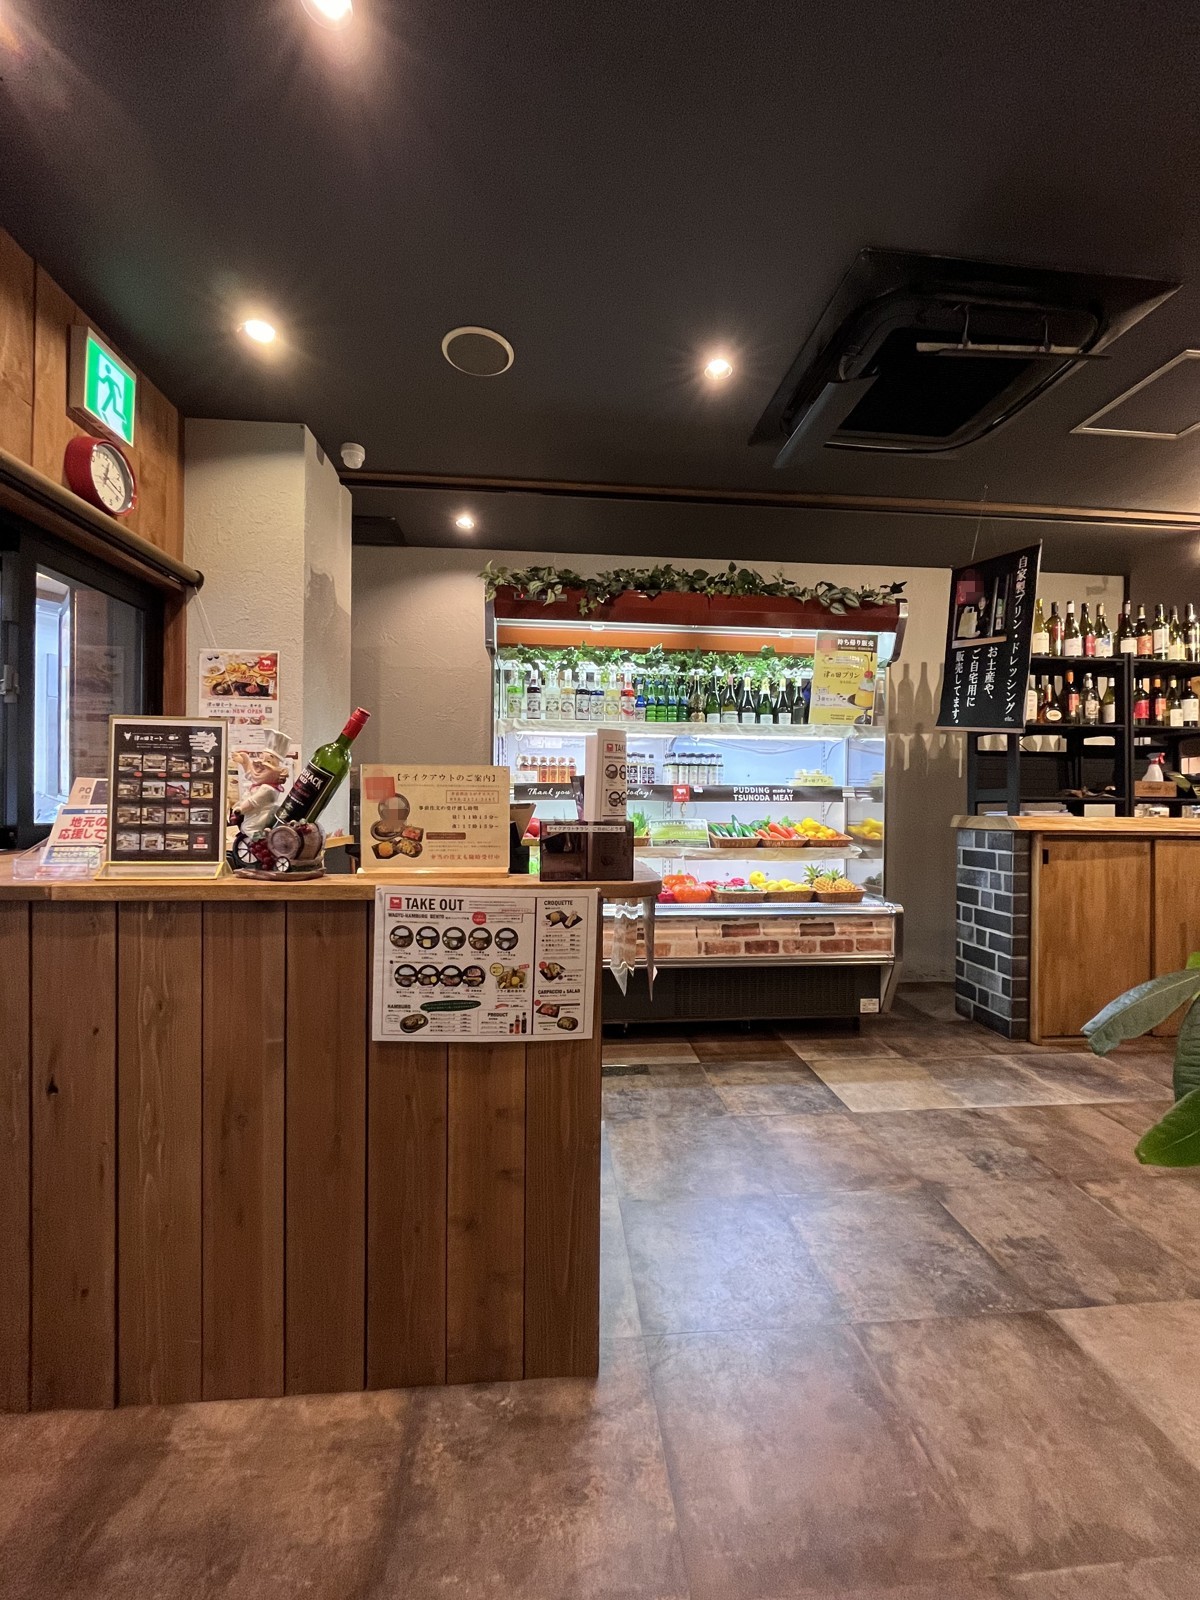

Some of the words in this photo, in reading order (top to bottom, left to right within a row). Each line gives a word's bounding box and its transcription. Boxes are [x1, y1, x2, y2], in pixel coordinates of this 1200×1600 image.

[1004, 555, 1029, 715] 自家製プリン・ドレッシング
[966, 647, 983, 708] ご自宅用に
[984, 646, 999, 700] お土産や、
[951, 650, 966, 724] 販売してます。
[397, 773, 497, 783] 【テイクアウトのご案内】
[527, 788, 554, 796] Thank
[733, 786, 770, 794] PUDDING
[733, 794, 771, 802] TSUNODA
[772, 794, 794, 802] MEAT
[404, 897, 437, 911] TAKE
[439, 898, 465, 911] OUT
[544, 899, 573, 907] CROQUETTE
